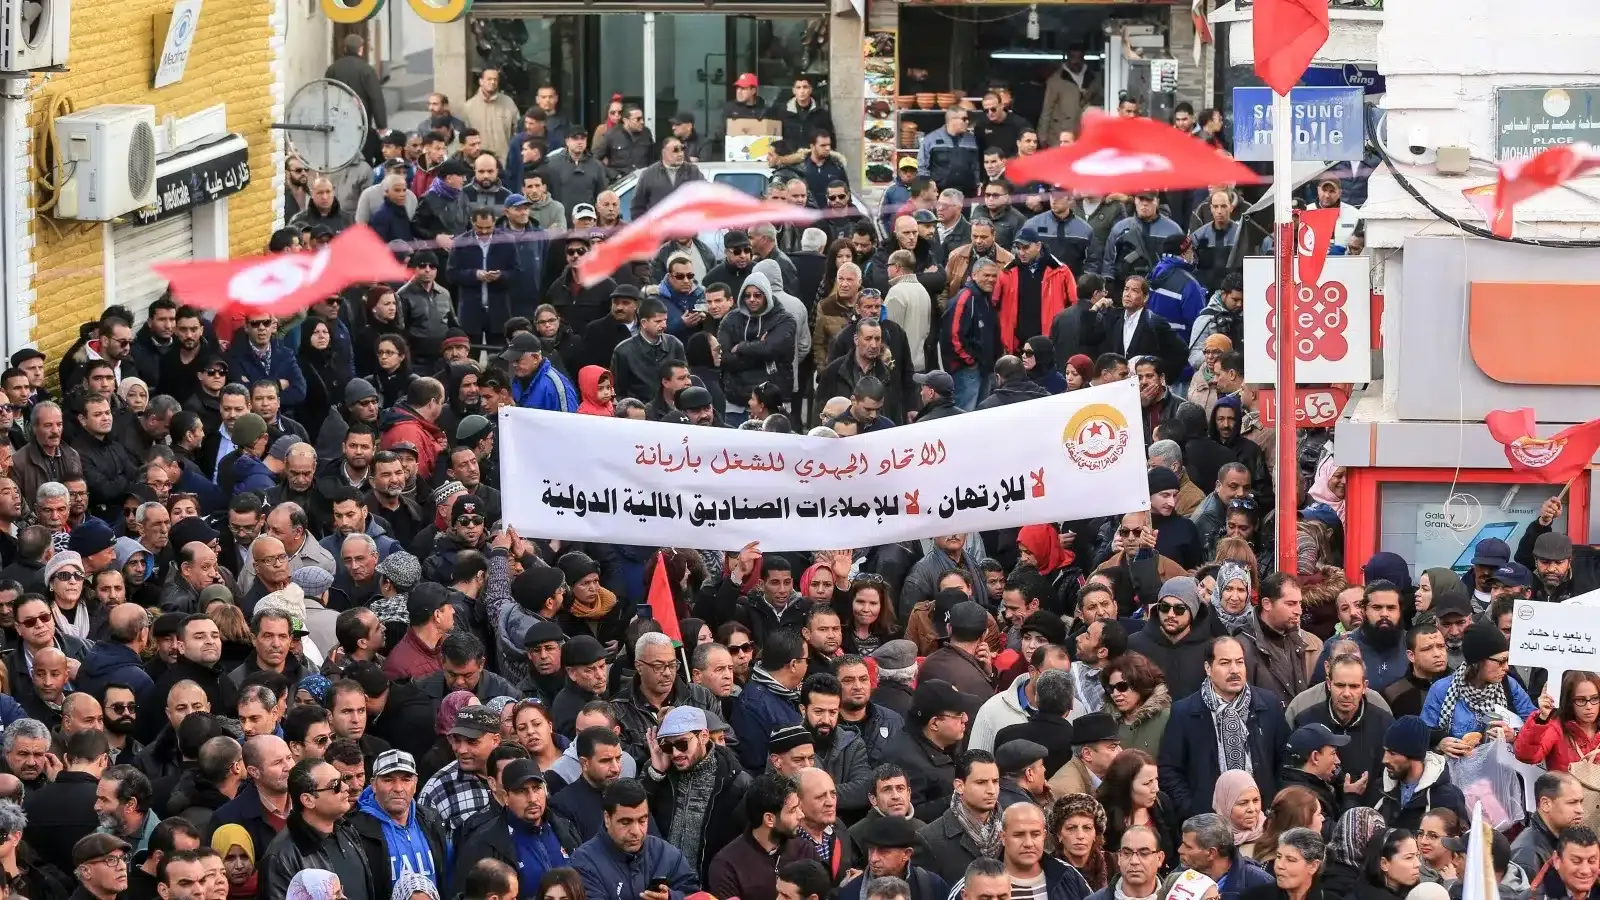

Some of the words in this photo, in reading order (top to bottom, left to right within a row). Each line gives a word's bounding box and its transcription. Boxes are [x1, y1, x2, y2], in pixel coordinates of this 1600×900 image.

[1349, 75, 1375, 86] Ring
[1253, 104, 1343, 119] SASUNG
[1532, 116, 1550, 134] علي
[1552, 119, 1576, 130] محمد
[1533, 136, 1574, 145] PLACE
[1309, 396, 1335, 420] 3G
[635, 435, 702, 474] بأريانة
[710, 448, 786, 475] للشغل
[794, 452, 867, 484] الجهوي
[1030, 467, 1045, 499] لا
[904, 489, 920, 516] لا
[938, 474, 1026, 520] للإرتهان
[689, 494, 791, 528] الصناديق
[796, 495, 900, 526] للإملاءات
[1424, 511, 1455, 521] Galay
[1527, 628, 1550, 637] حشاد
[1552, 629, 1560, 640] يا
[1563, 631, 1582, 642] بلعيد
[1585, 632, 1592, 643] يا
[1519, 642, 1540, 652] البلاد
[1543, 644, 1565, 655] باعت
[1568, 643, 1597, 655] السلطة
